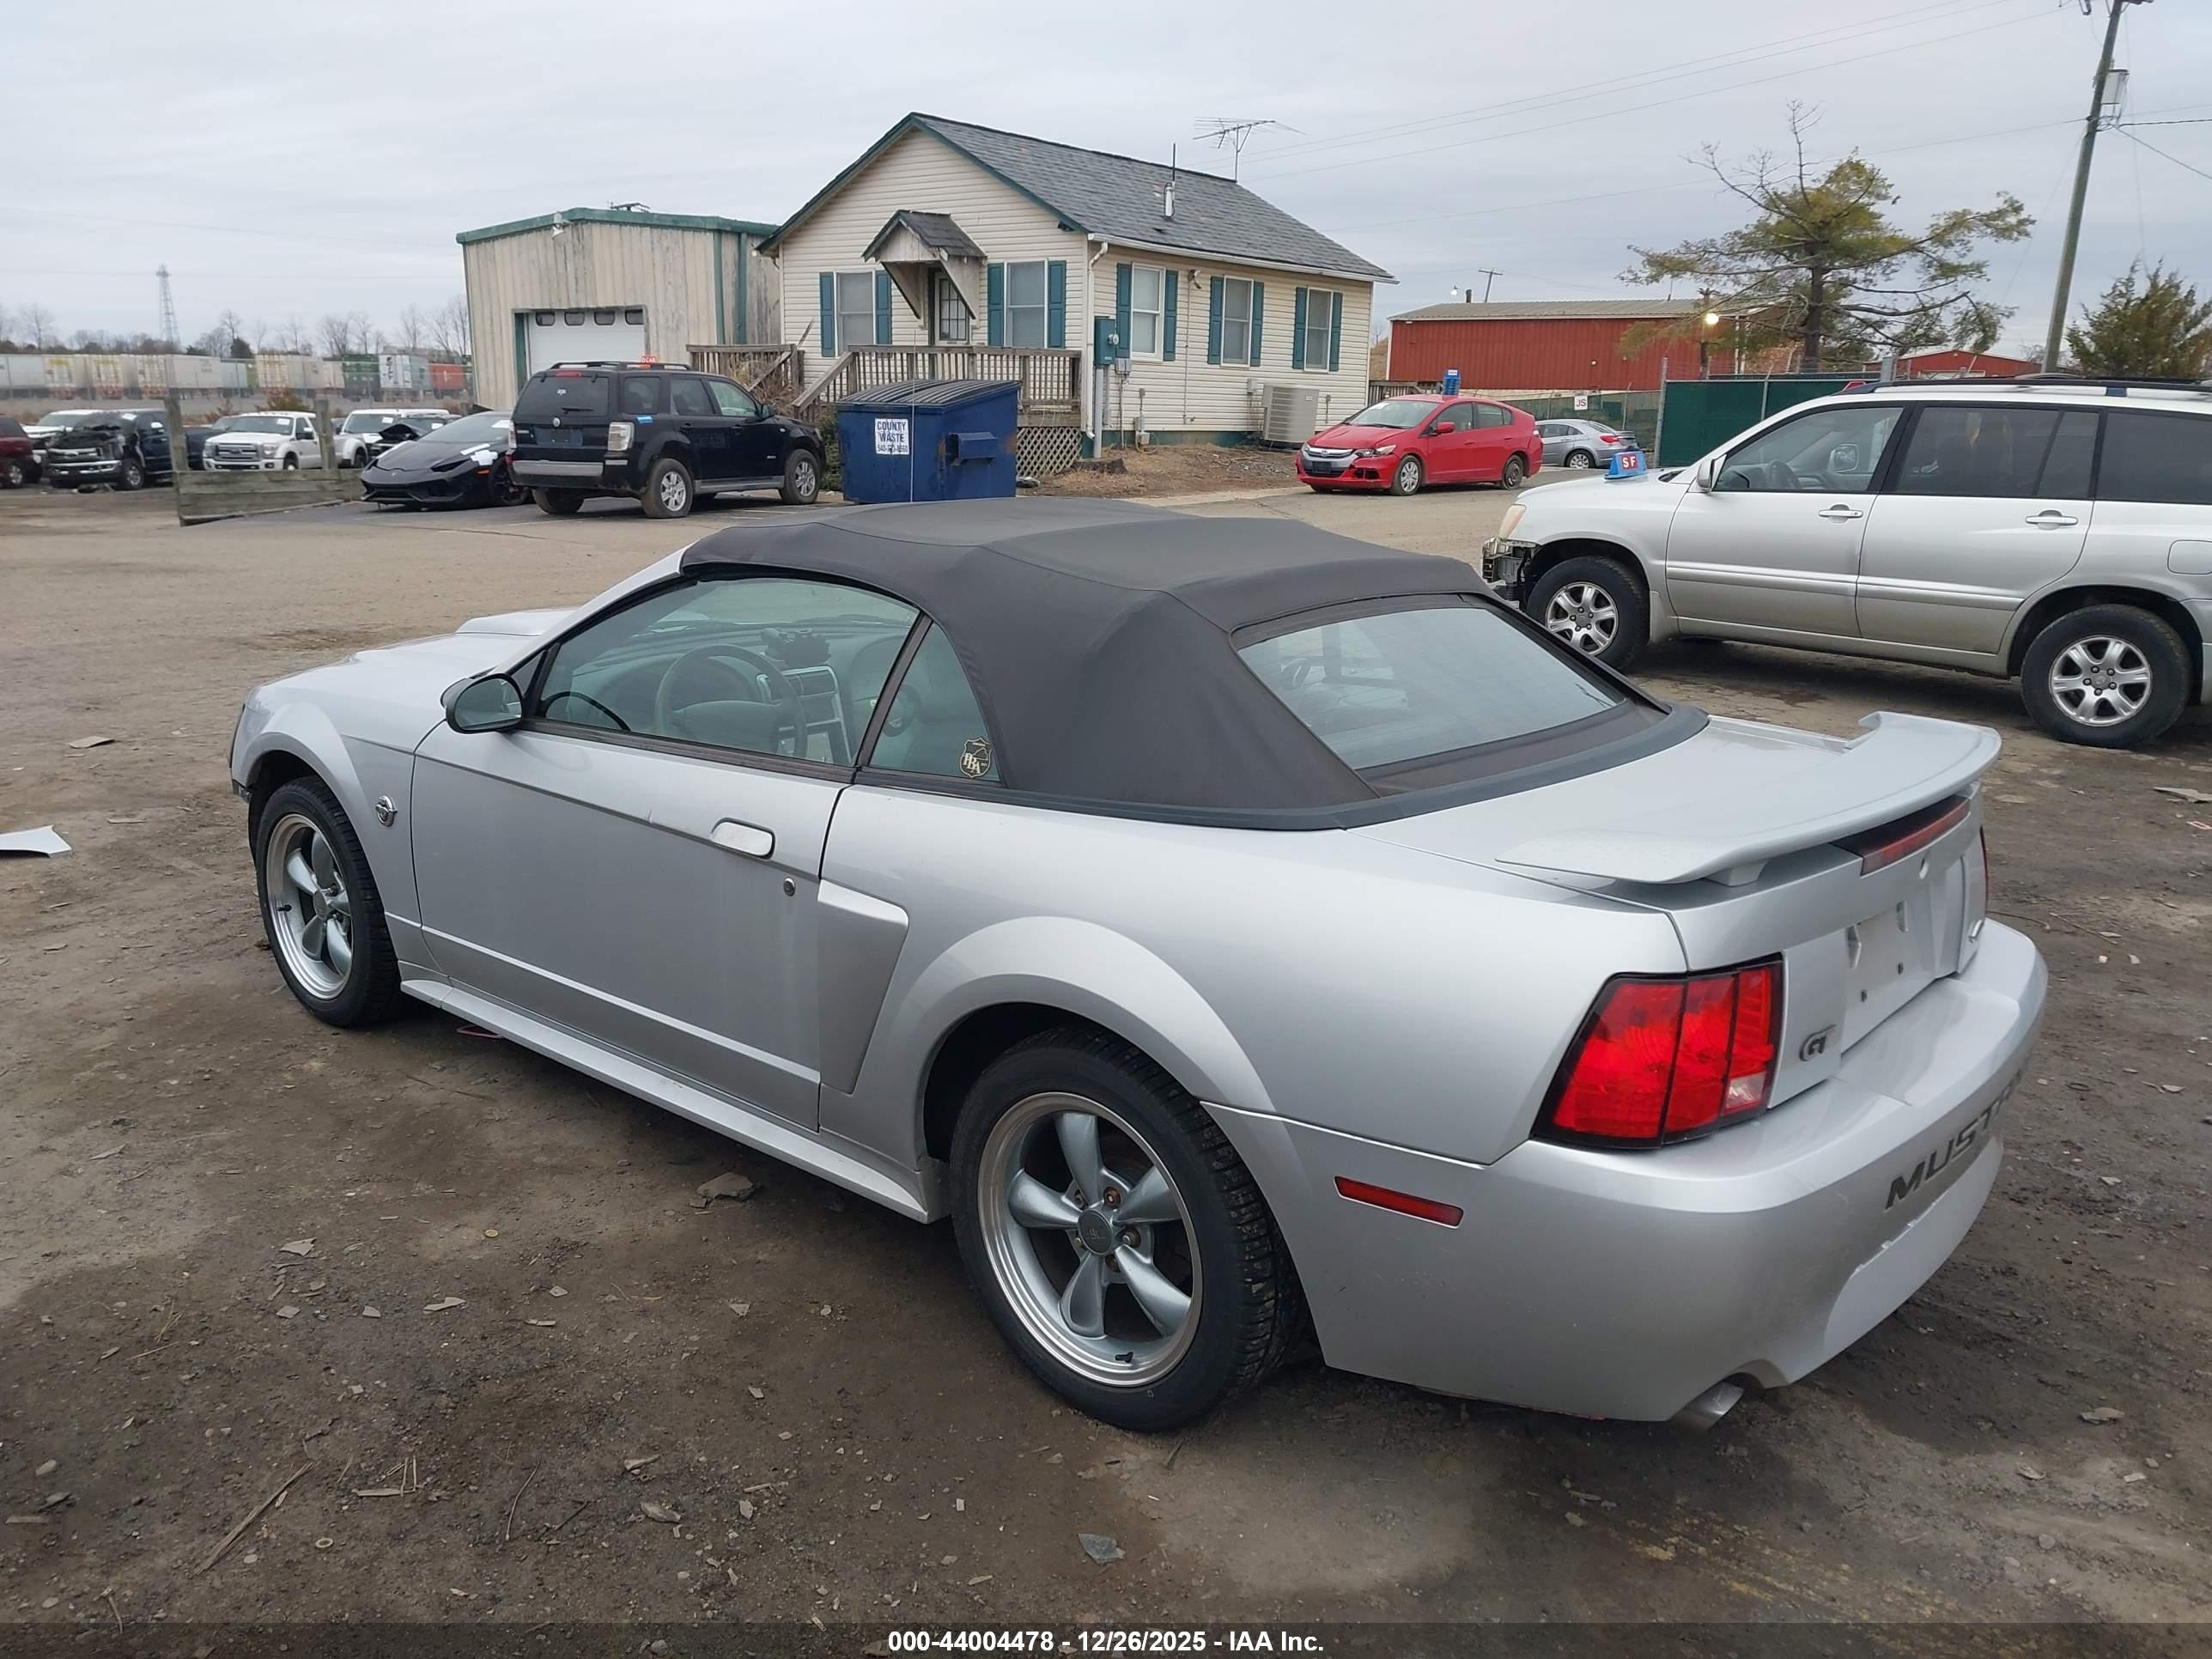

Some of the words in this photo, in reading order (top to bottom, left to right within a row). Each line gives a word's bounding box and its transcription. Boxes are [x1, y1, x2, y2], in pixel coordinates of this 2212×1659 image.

[1577, 398, 1586, 407] JS
[877, 422, 906, 430] COUNTY
[879, 433, 905, 442] WASTE
[1799, 1024, 1837, 1062] GT
[1886, 1070, 2021, 1210] MUST
